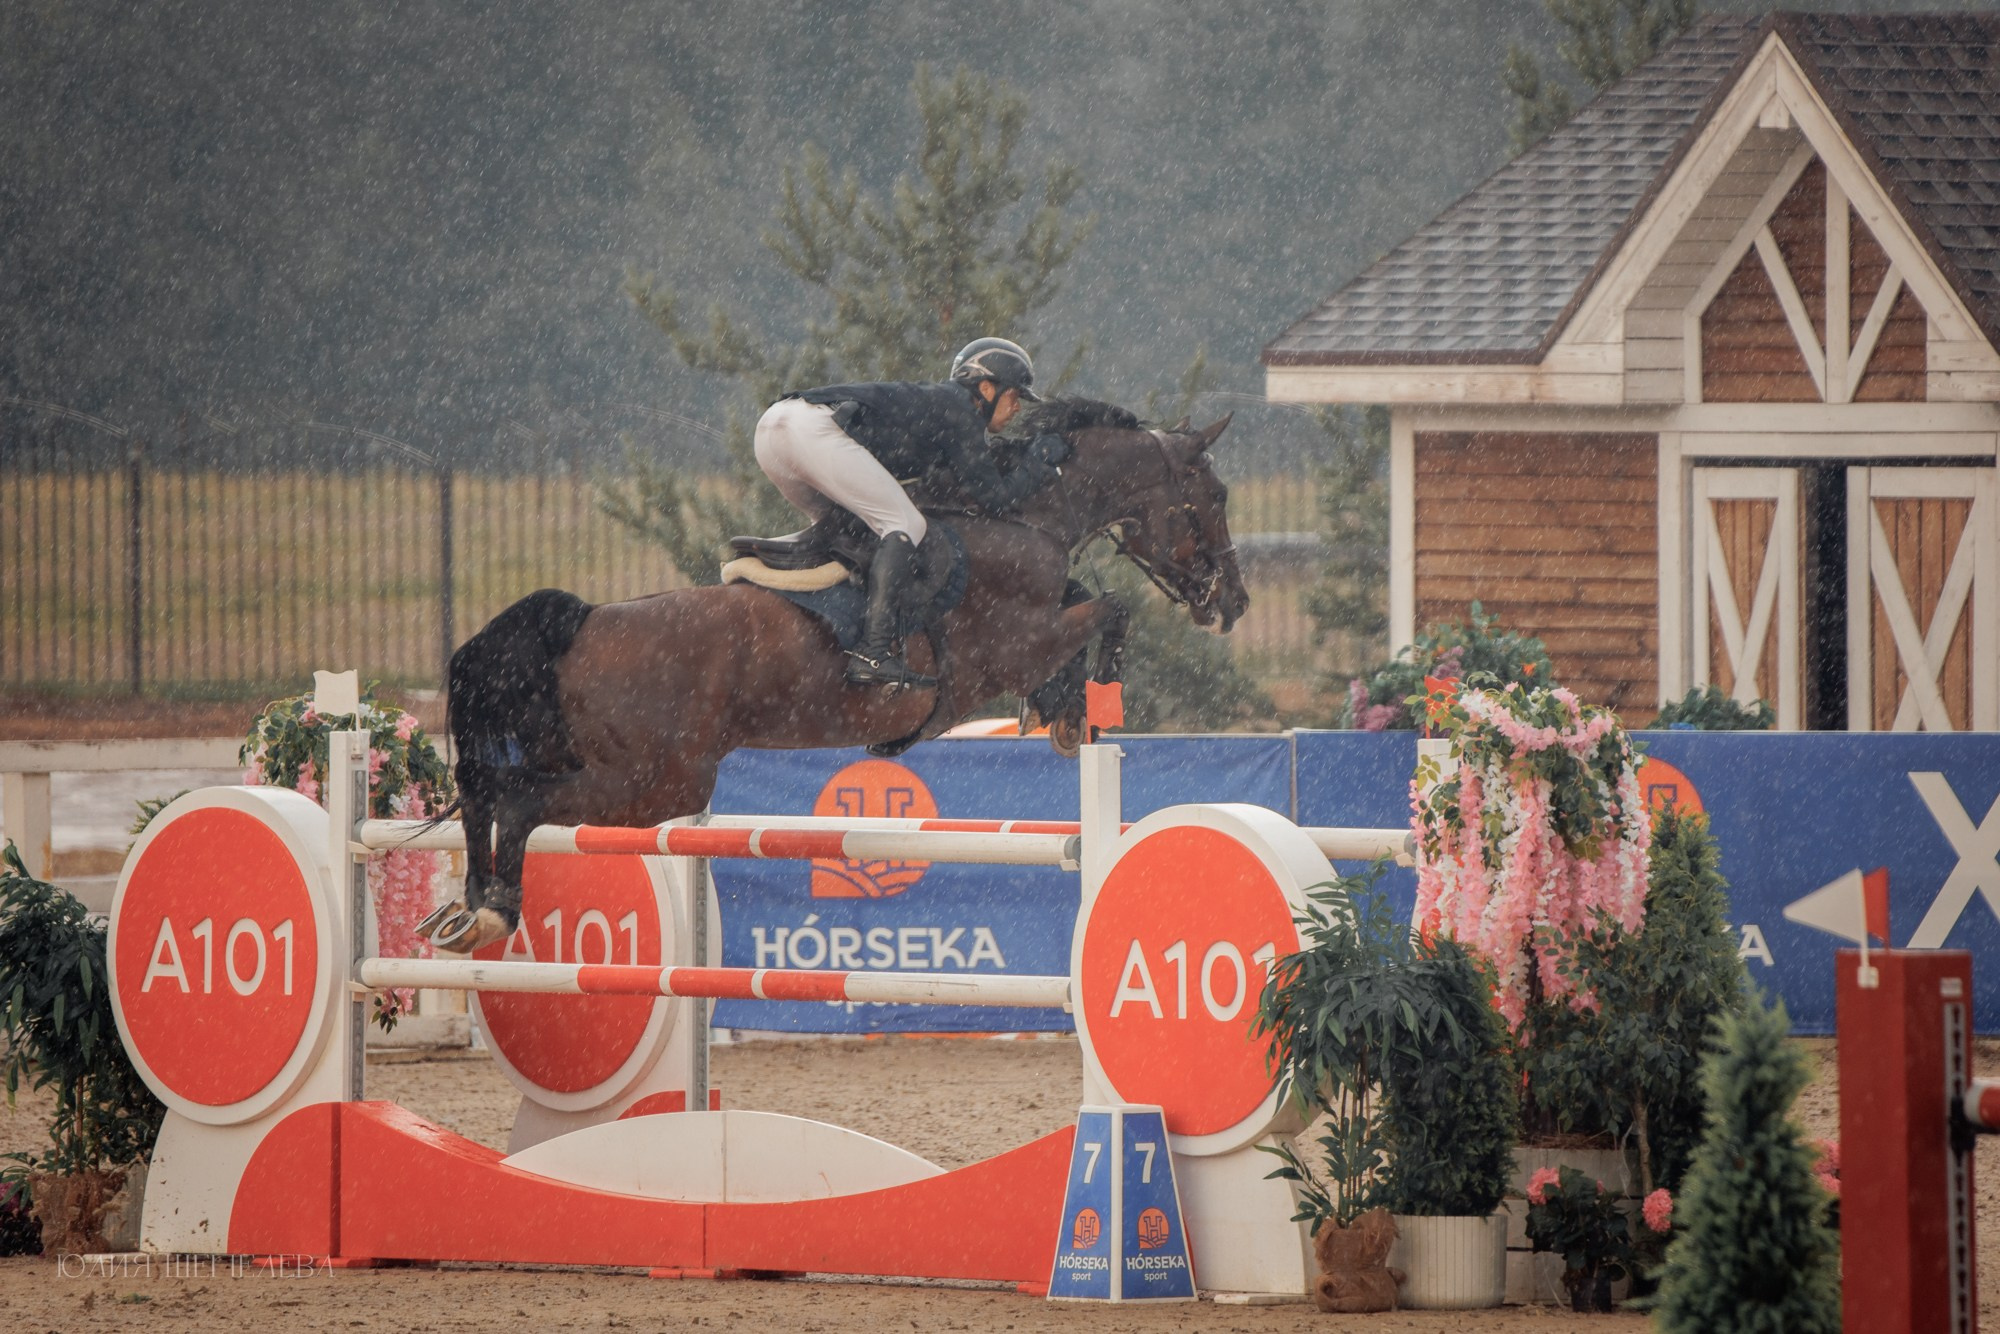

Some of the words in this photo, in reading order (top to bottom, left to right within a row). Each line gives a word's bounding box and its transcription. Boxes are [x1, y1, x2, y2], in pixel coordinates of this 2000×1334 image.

[141, 916, 294, 997] A101
[502, 908, 638, 967] A101
[752, 913, 1006, 968] HÓRSEKA
[1083, 1142, 1102, 1184] 7
[1134, 1142, 1156, 1184] 7
[1059, 1253, 1109, 1271] HÓRSEKA
[1072, 1271, 1092, 1282] sport
[1126, 1253, 1186, 1271] HÓRSEKA
[1144, 1271, 1168, 1282] sport
